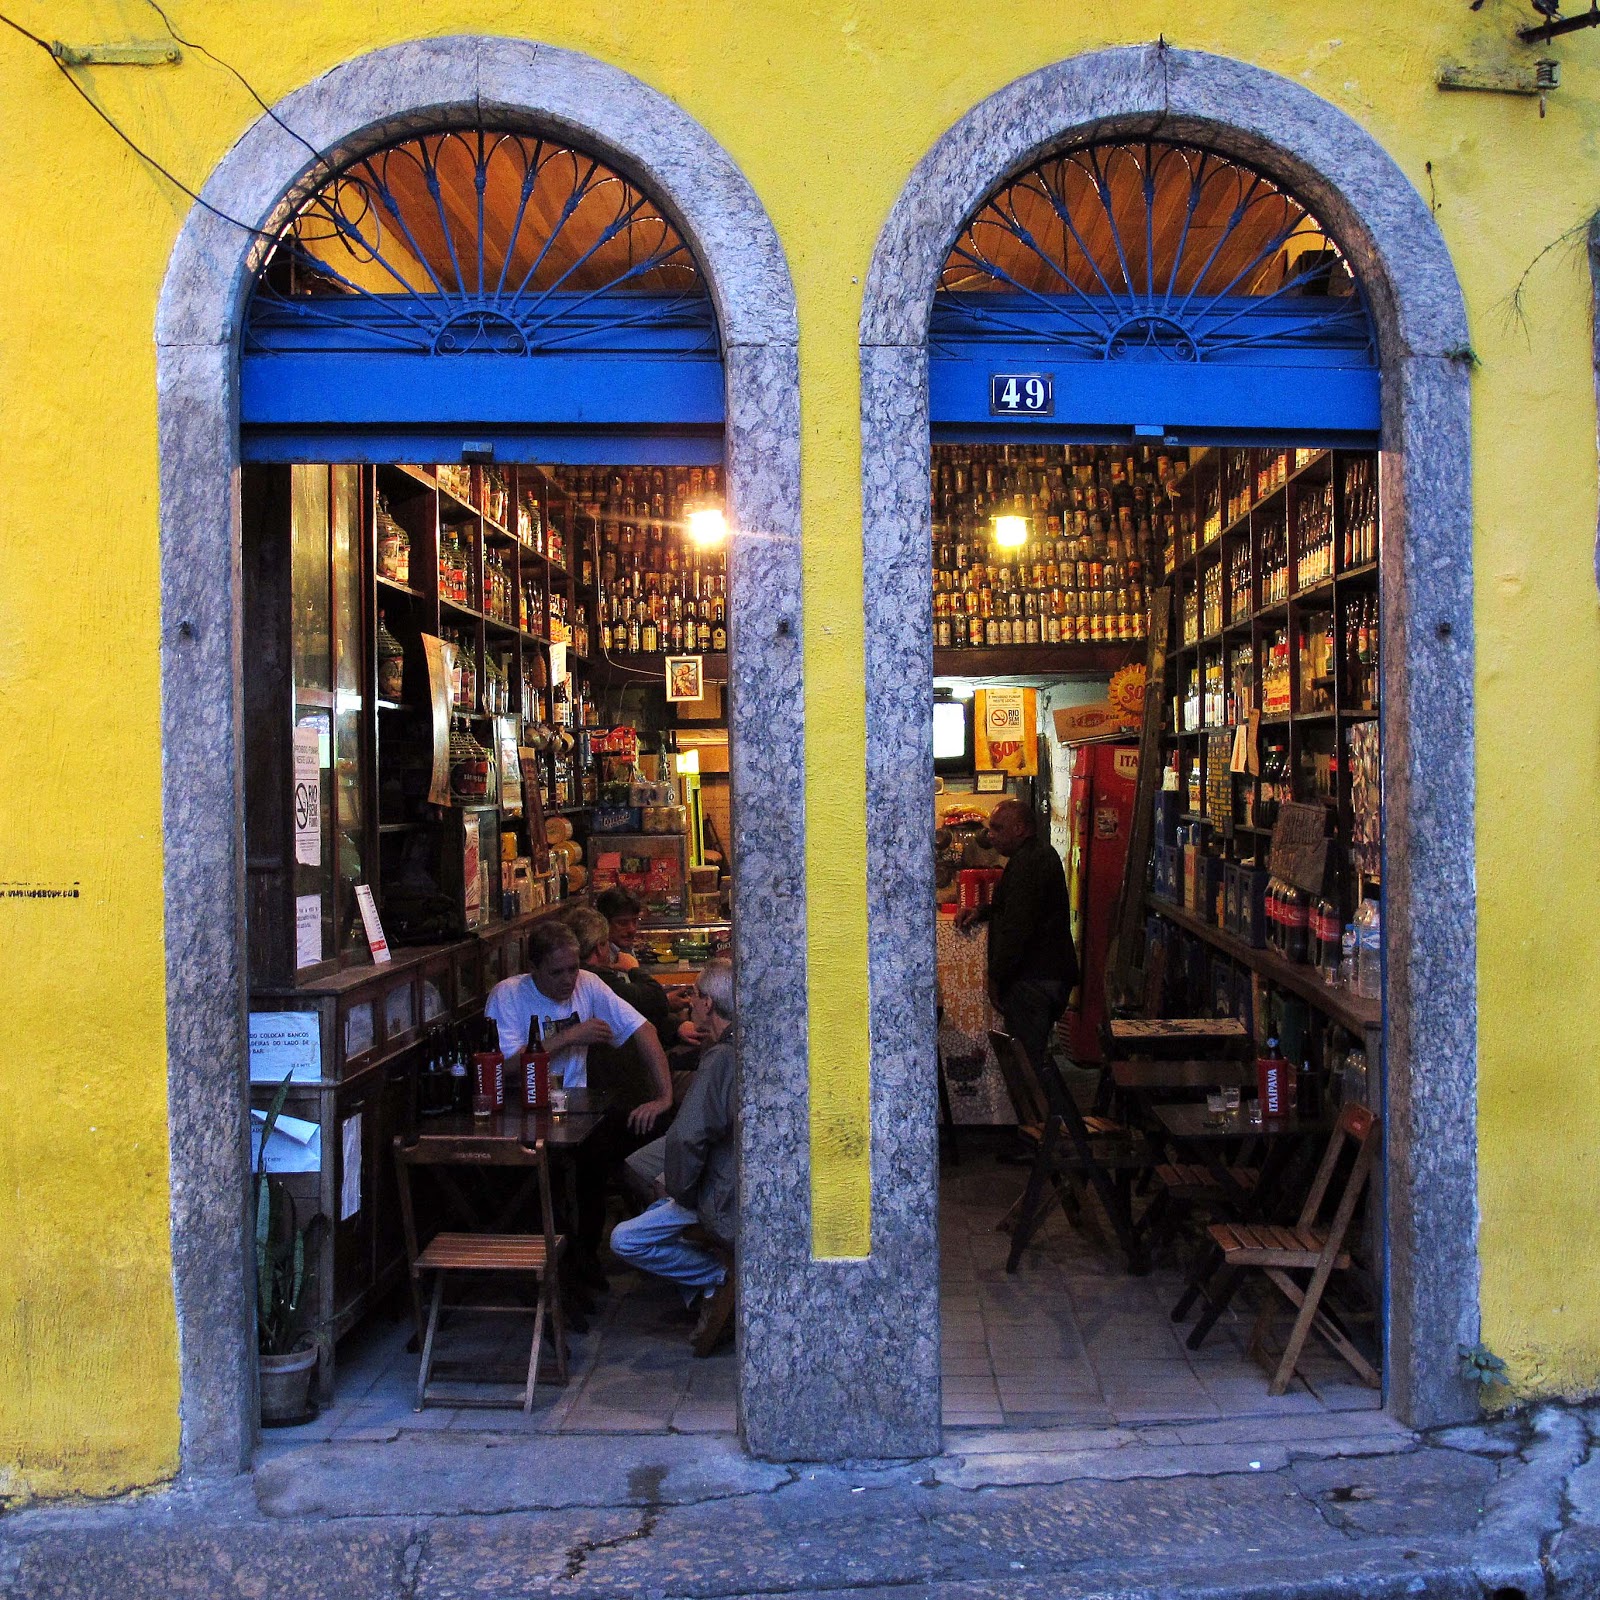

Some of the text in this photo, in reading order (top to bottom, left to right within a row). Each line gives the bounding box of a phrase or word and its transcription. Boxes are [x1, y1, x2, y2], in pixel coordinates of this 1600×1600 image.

[1001, 378, 1044, 409] 49
[1008, 709, 1019, 717] RIO
[308, 784, 318, 803] RIO
[495, 1062, 504, 1105] ITAIPAVA
[526, 1061, 537, 1104] ITAIPAVA
[1267, 1068, 1279, 1112] ITAIPAVA
